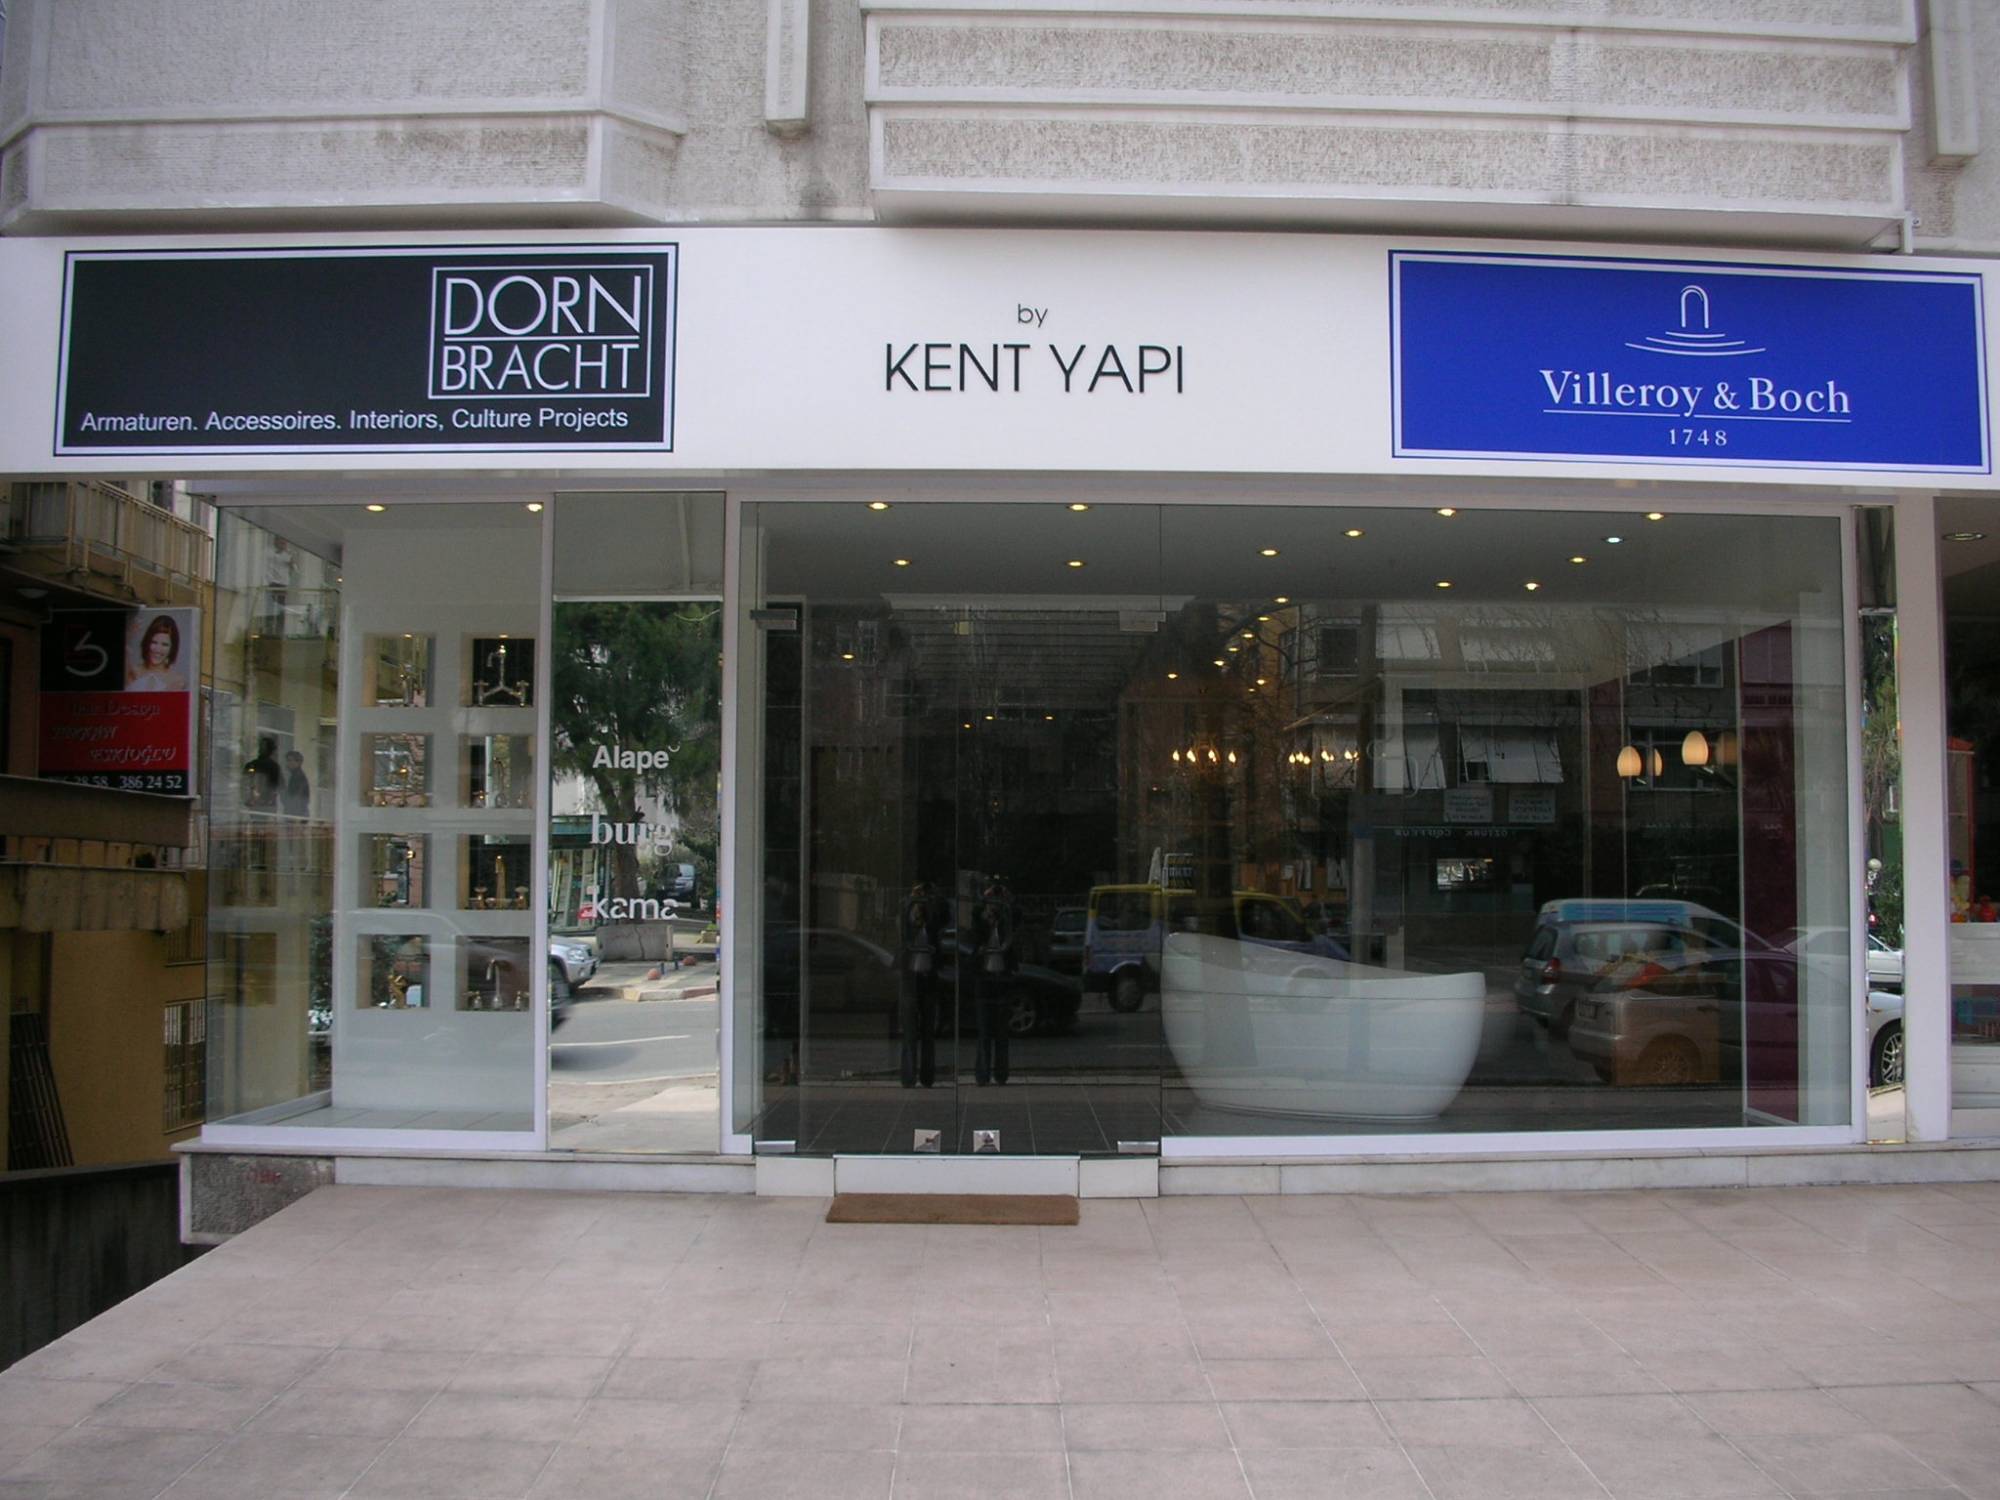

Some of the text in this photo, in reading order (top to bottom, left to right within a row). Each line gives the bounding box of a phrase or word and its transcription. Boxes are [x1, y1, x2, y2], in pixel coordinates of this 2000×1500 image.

[444, 275, 641, 335] DORN
[1017, 303, 1048, 327] by
[441, 343, 640, 391] BRACHT
[886, 343, 1183, 393] KENT YAPI
[1539, 369, 1851, 417] Villeroy & Boch
[80, 407, 629, 432] Armaturen. Accessoires. Interiors, Culture Projects
[1669, 428, 1728, 447] 1748
[592, 744, 670, 774] Alape
[119, 774, 144, 789] 386
[146, 774, 163, 789] 24
[165, 774, 183, 789] 52
[589, 811, 673, 856] burg
[591, 888, 679, 920] kama
